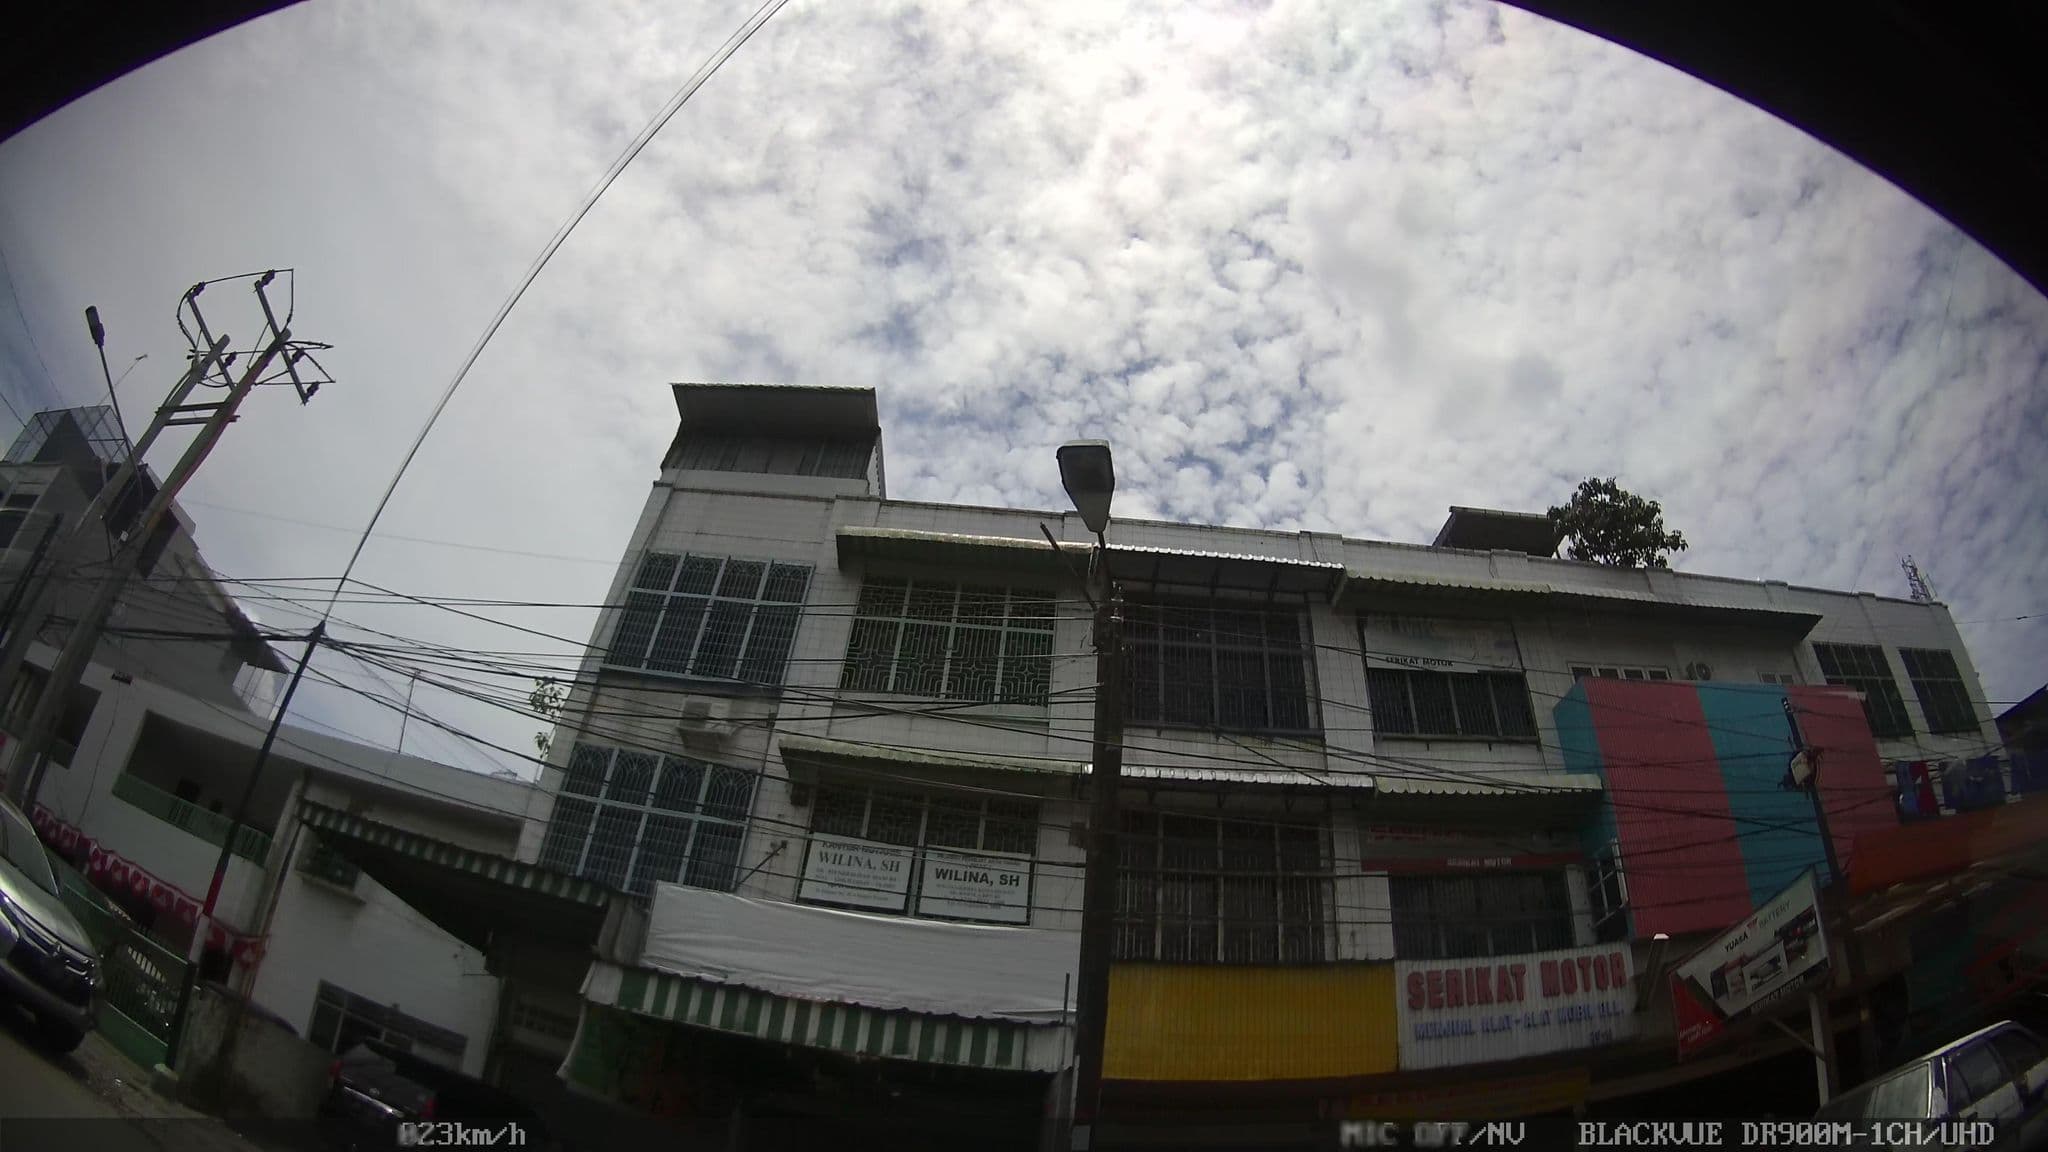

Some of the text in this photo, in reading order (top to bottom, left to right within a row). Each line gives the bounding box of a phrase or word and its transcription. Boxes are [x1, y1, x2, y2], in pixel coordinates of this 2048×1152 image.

[880, 859, 901, 872] SH
[935, 867, 1020, 886] WILINA, SH
[1724, 931, 1749, 953] YUASA
[1407, 952, 1628, 1010] SERIKAT MOTOR
